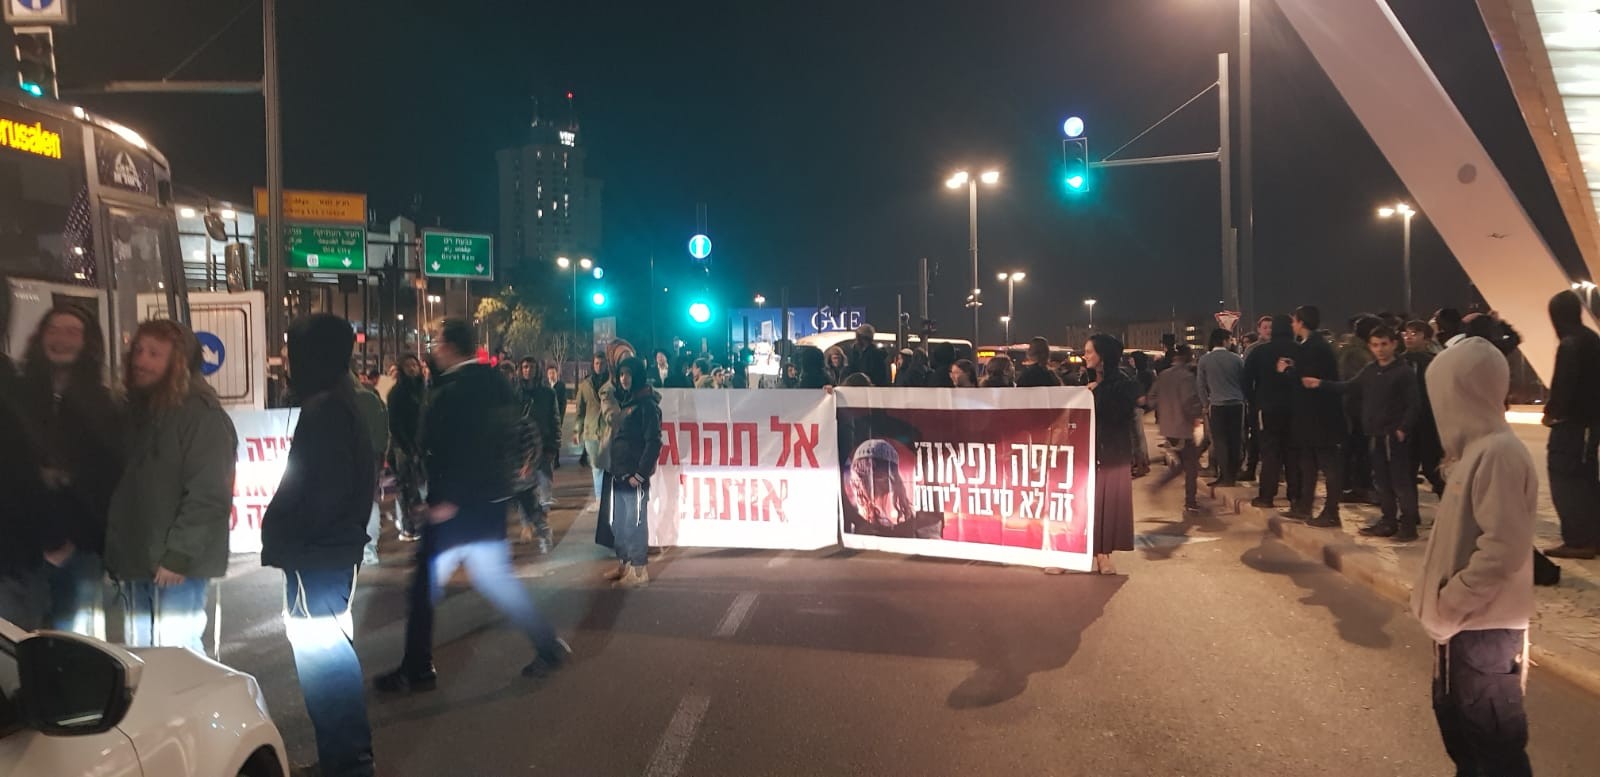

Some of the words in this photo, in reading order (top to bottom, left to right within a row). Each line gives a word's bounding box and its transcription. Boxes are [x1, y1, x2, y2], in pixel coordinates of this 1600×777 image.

[658, 422, 758, 466] תהרג
[770, 415, 819, 468] אל
[914, 441, 997, 486] ופאות
[1011, 443, 1075, 490] כיפה
[967, 487, 1014, 517] סיבה
[1019, 487, 1044, 520] לא
[1049, 491, 1075, 522] זה
